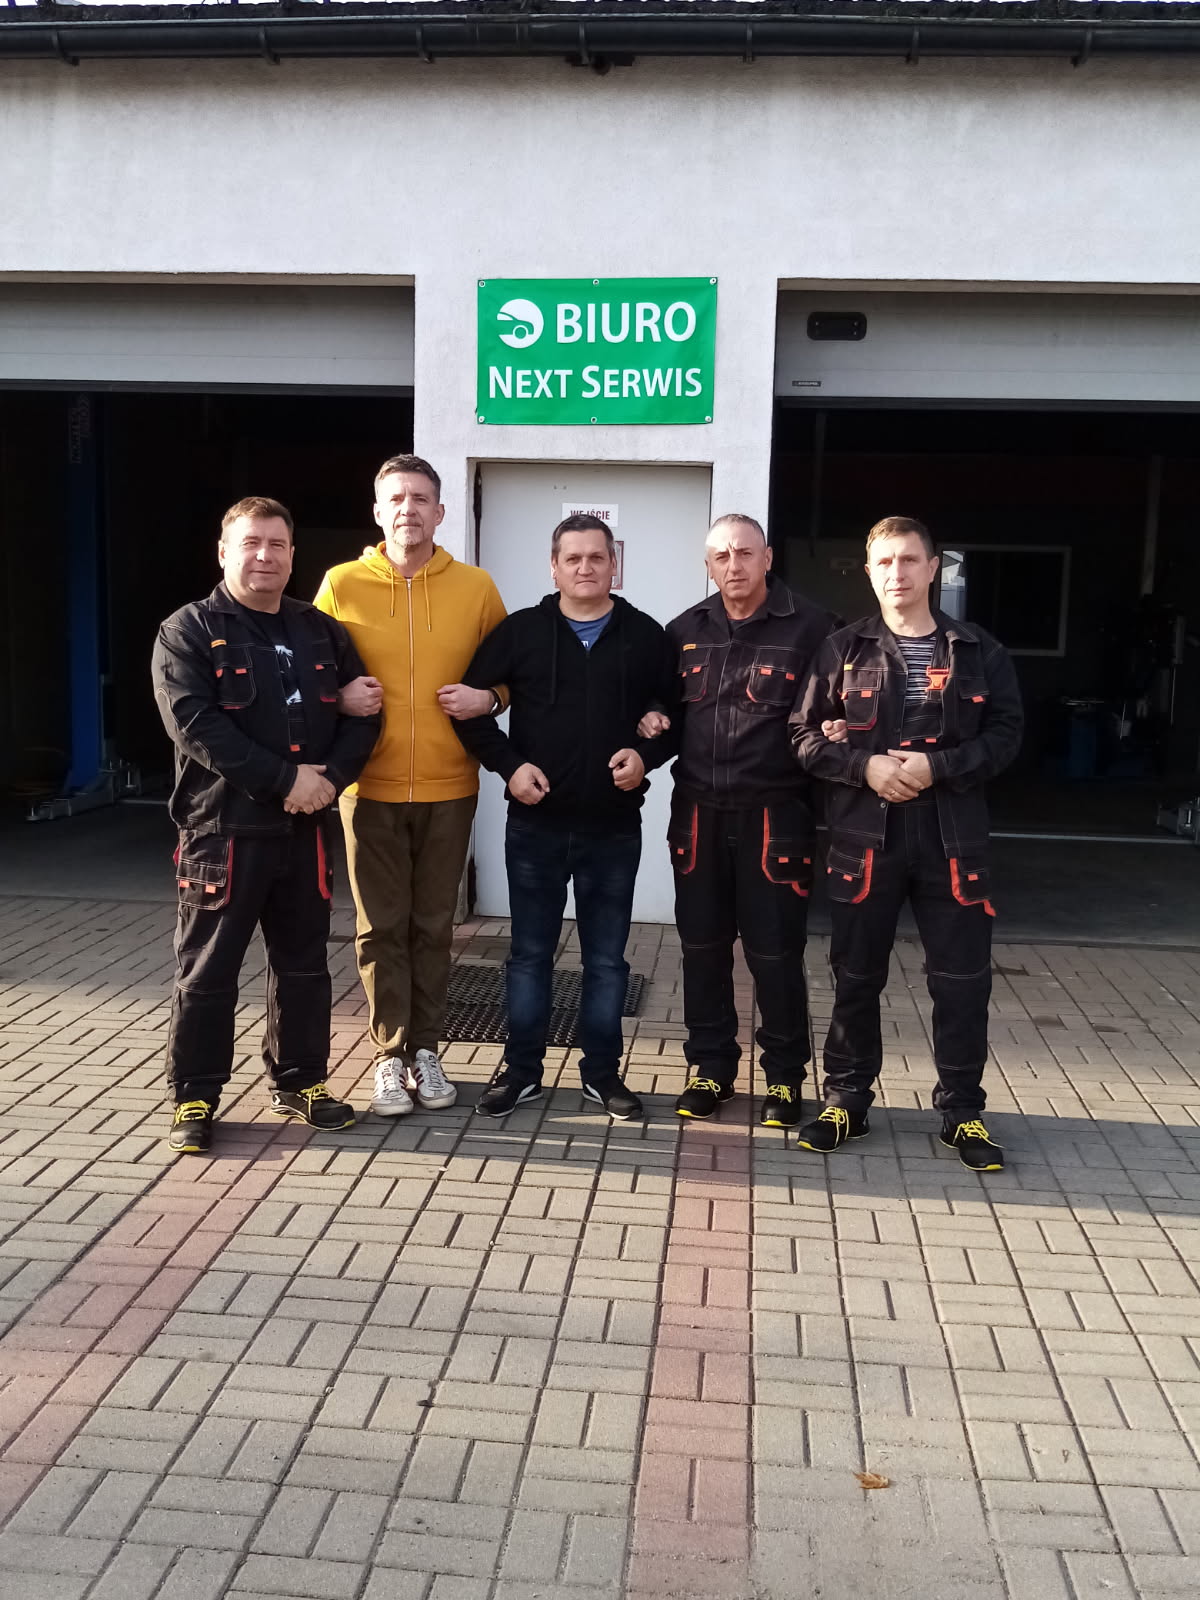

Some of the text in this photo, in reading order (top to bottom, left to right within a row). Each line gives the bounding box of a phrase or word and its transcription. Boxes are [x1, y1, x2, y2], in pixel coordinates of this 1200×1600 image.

[556, 301, 697, 344] BIURO
[489, 365, 703, 399] NEXT SERWIS
